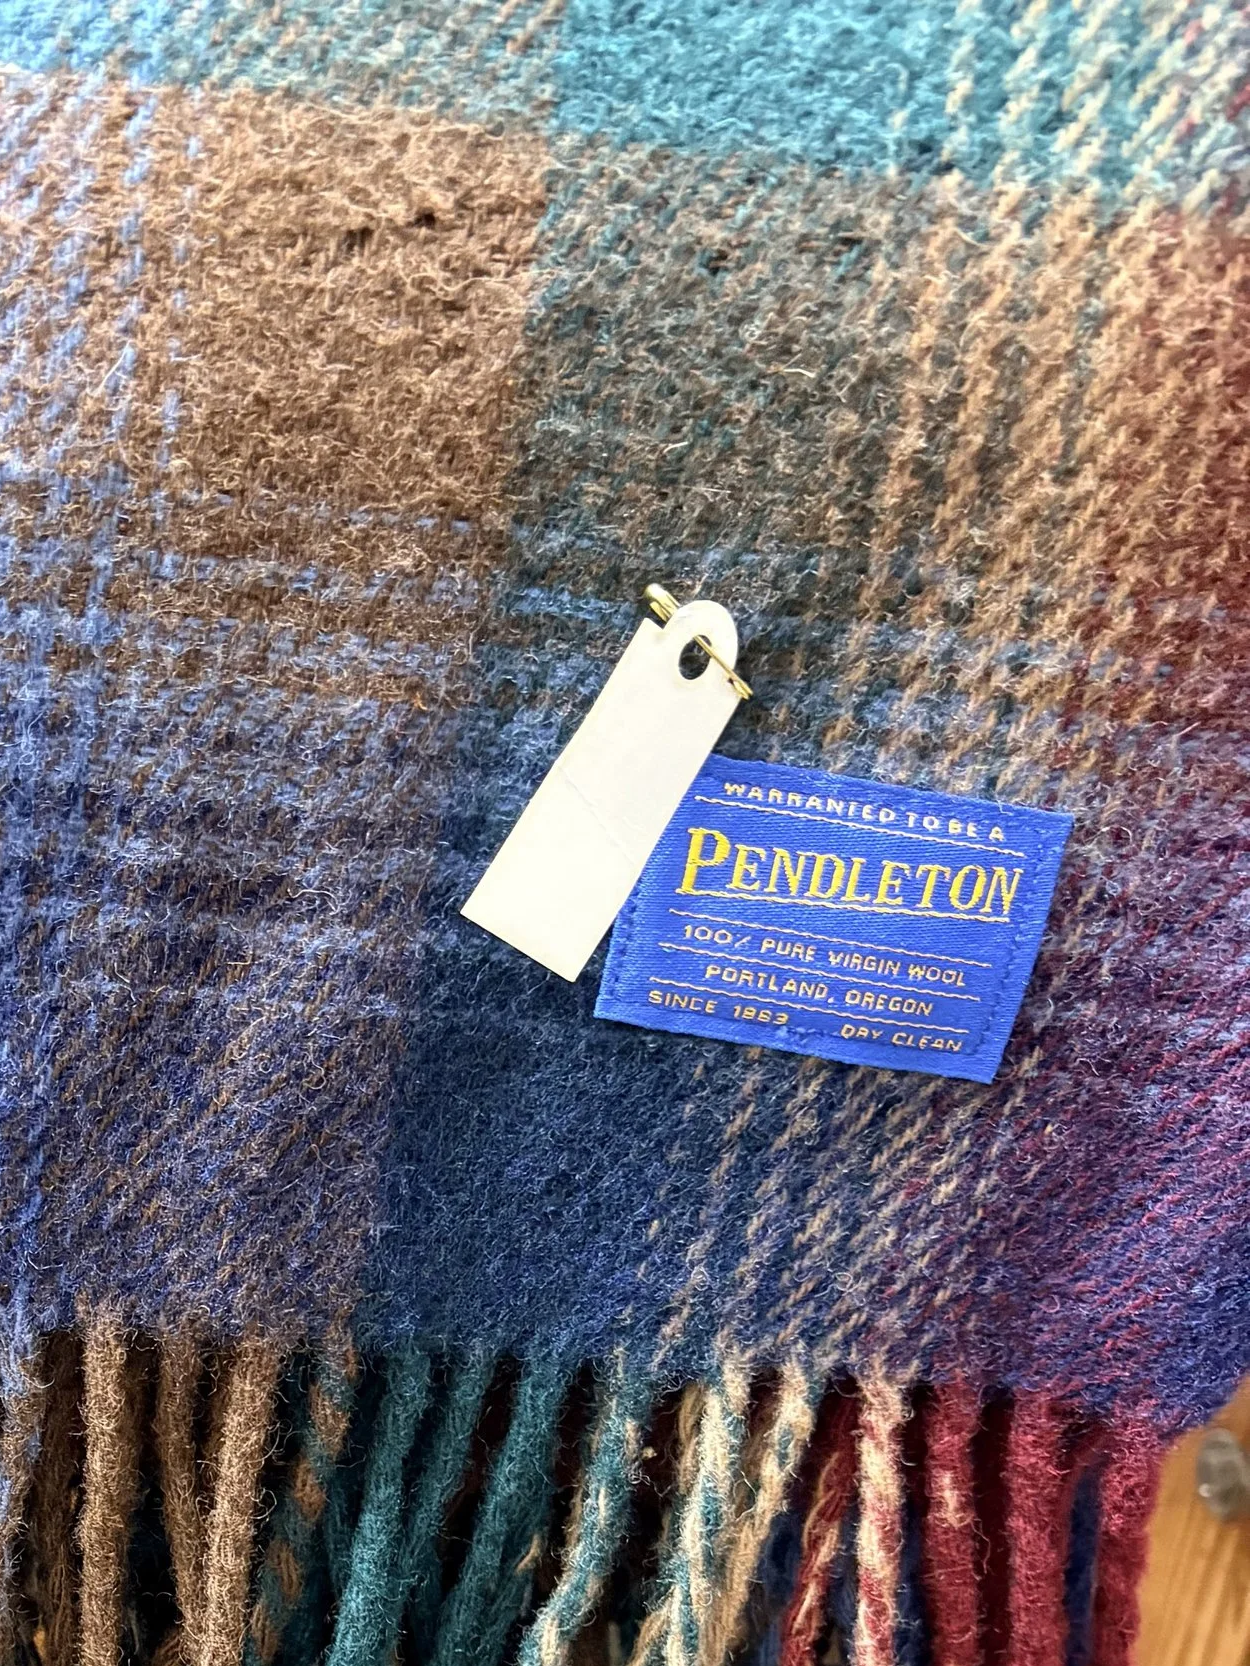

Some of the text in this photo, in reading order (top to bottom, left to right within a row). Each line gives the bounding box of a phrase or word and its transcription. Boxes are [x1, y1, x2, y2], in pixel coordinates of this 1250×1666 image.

[723, 782, 1006, 842] WARRANTED TO BE A
[674, 827, 1024, 915] PENDLETON
[760, 937, 818, 963] PURE
[828, 950, 901, 977] VIRGIN
[907, 963, 966, 987] WOOL
[648, 990, 719, 1014] SINCE
[844, 988, 934, 1017] OREGON
[840, 1022, 963, 1053] DRY CLEAN
